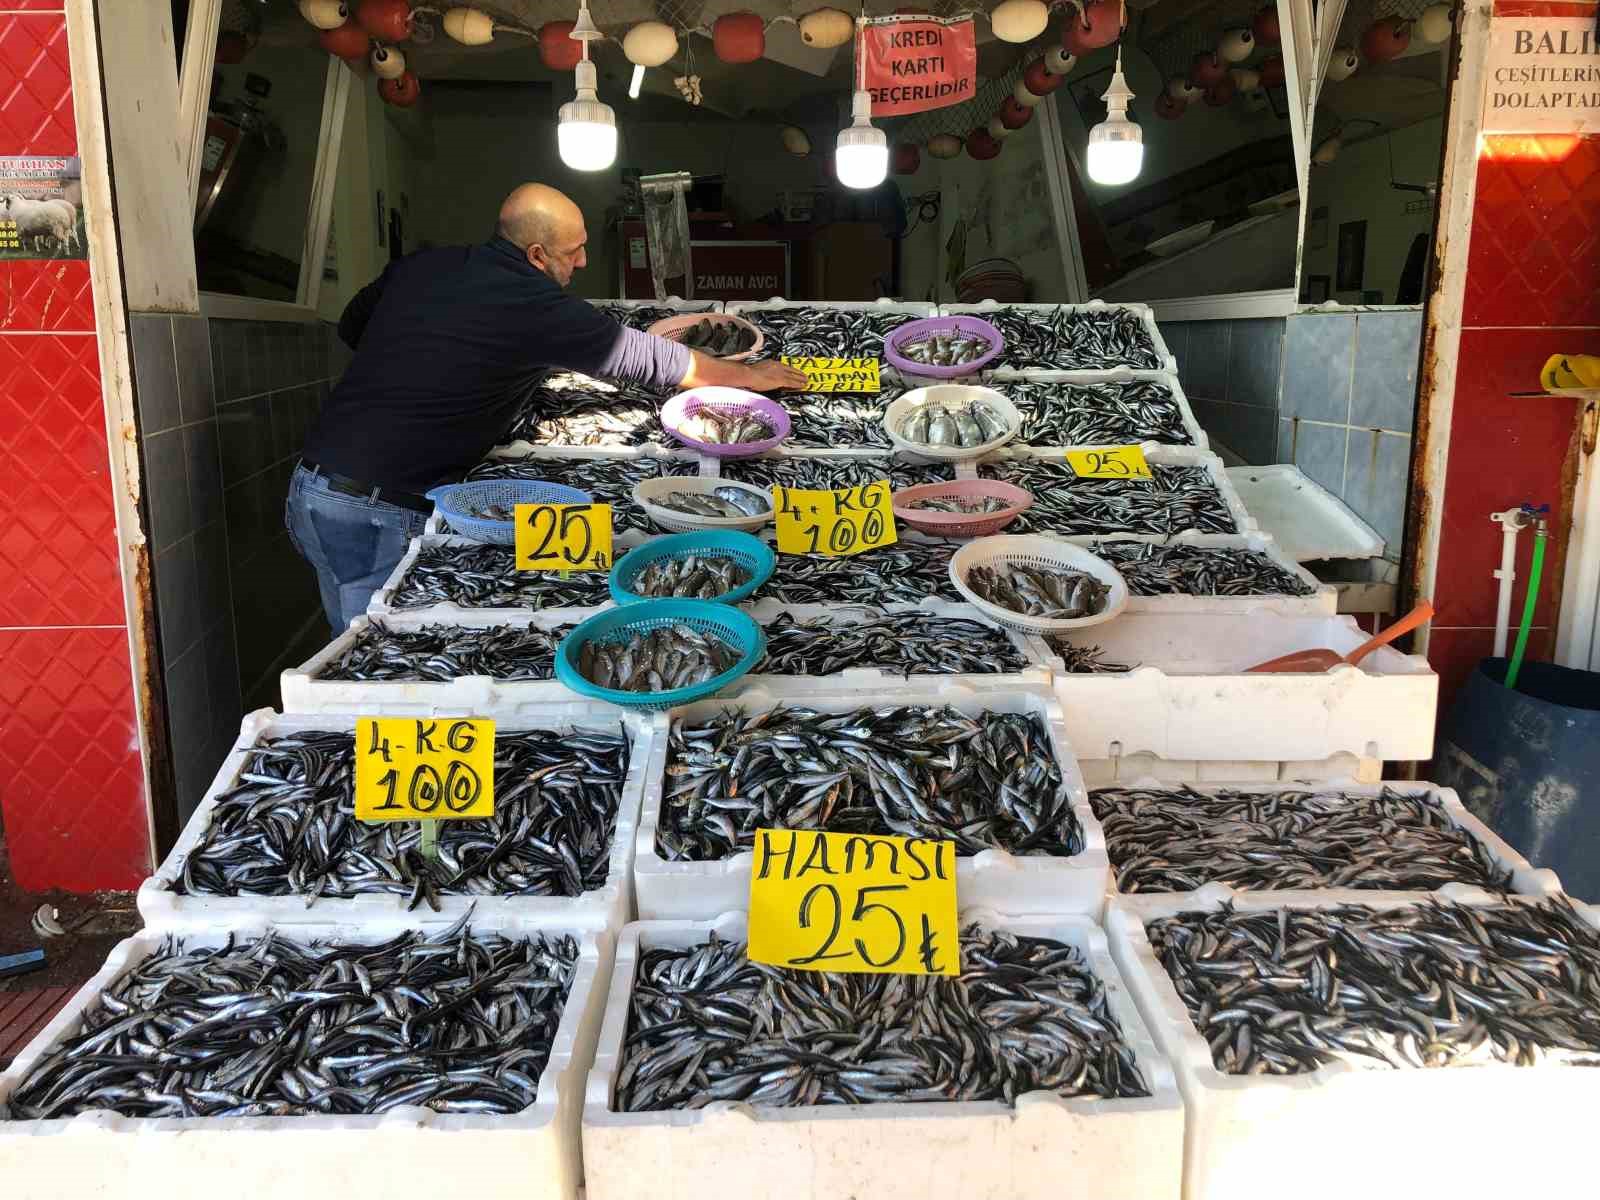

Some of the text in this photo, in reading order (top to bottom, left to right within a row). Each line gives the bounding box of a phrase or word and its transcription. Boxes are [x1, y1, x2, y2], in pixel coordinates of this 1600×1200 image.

[891, 29, 943, 48] KREDİ
[1514, 30, 1600, 55] BALI
[892, 56, 944, 76] KARTI
[697, 275, 744, 289] ZAMAN
[802, 509, 884, 553] 100
[372, 760, 482, 812] 100
